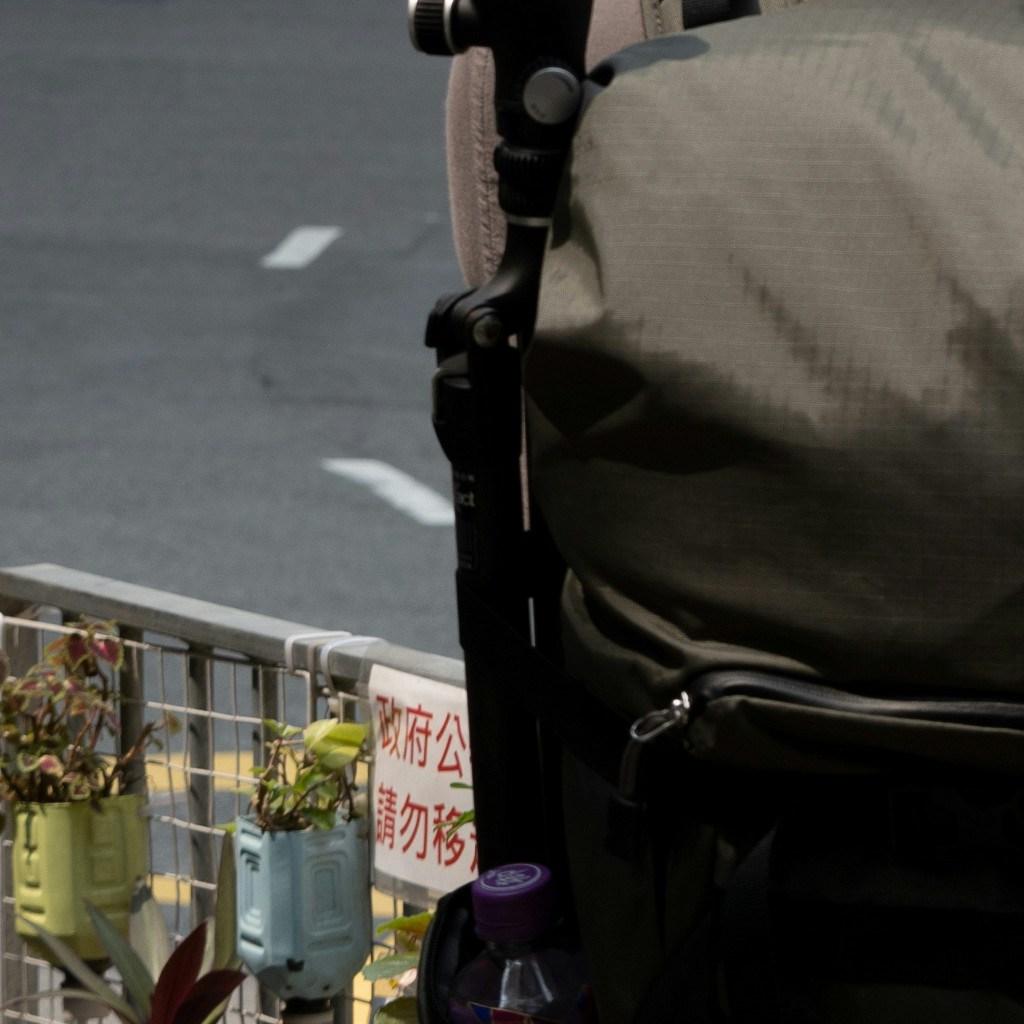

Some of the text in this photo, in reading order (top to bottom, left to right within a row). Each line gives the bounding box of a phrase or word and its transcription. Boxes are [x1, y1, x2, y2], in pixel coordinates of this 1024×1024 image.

[376, 694, 473, 778] 政府公
[375, 782, 478, 872] 請勿移
